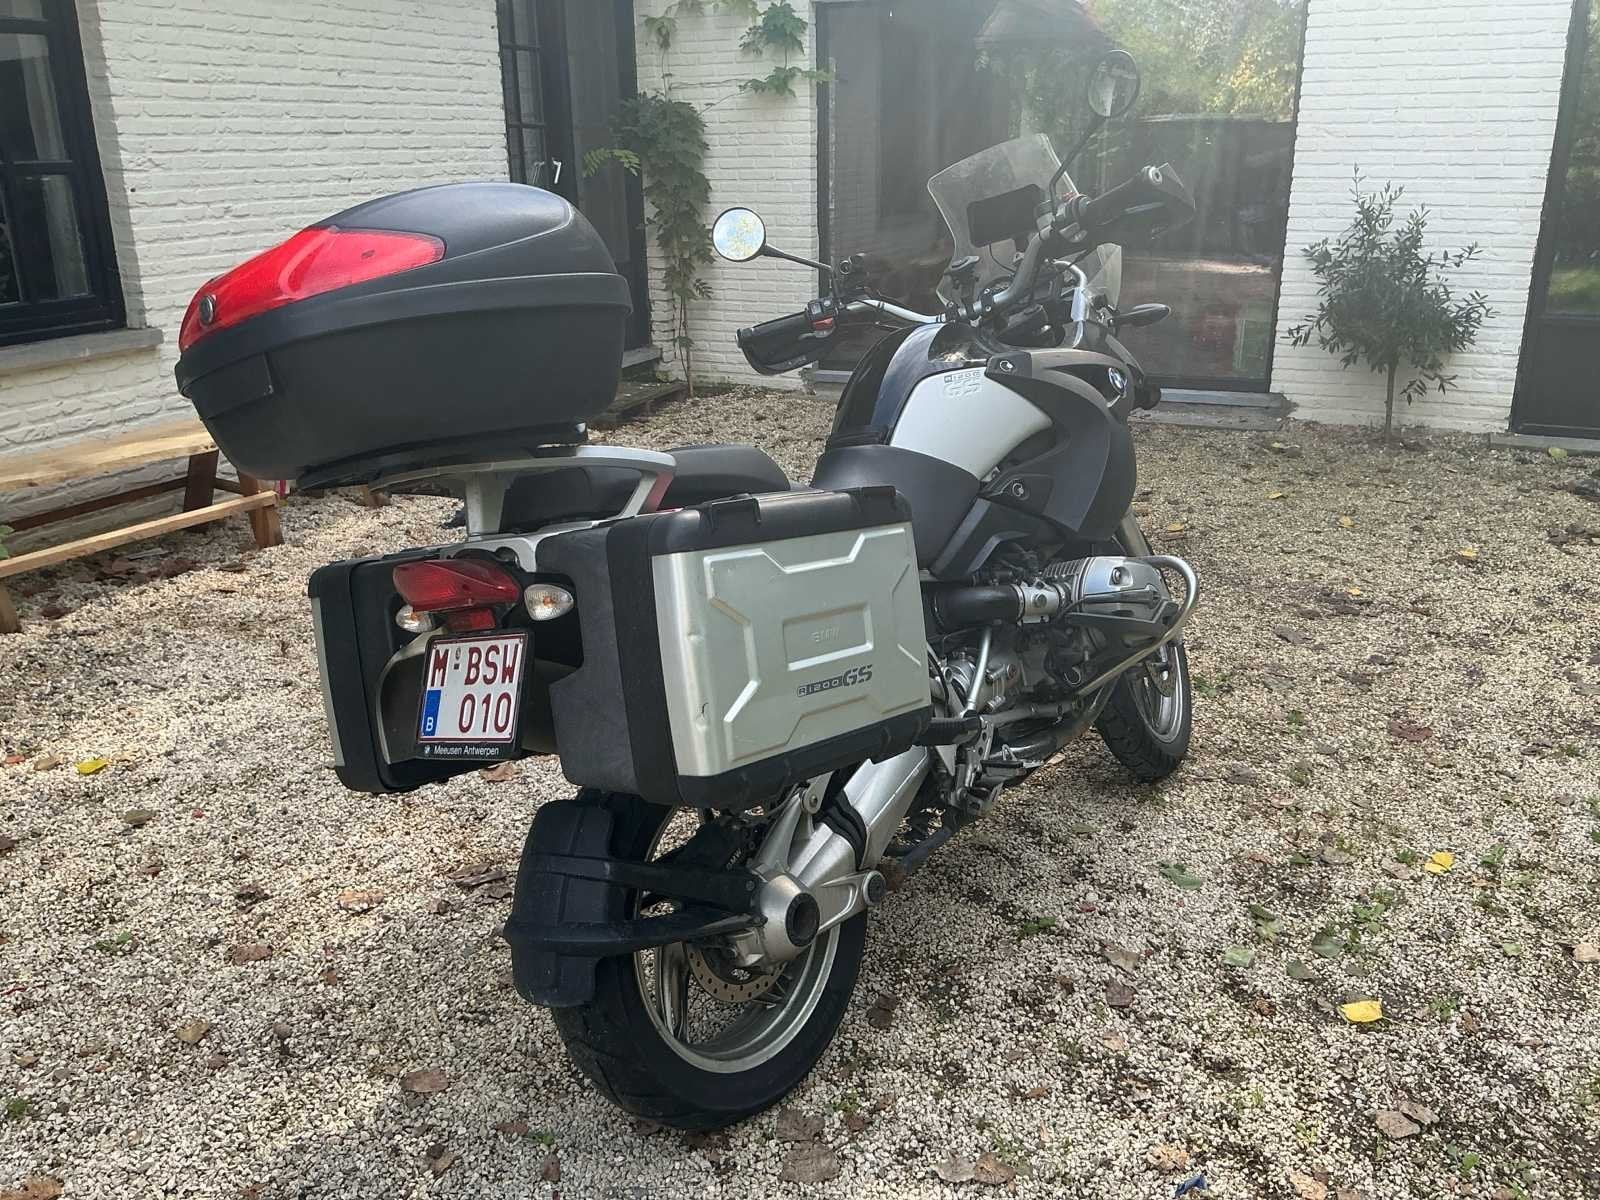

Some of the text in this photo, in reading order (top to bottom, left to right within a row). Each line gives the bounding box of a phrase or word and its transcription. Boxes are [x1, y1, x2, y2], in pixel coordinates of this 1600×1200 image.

[459, 692, 512, 733] 010
[425, 717, 434, 731] B
[433, 745, 499, 757] Meeusen Antwerpen
